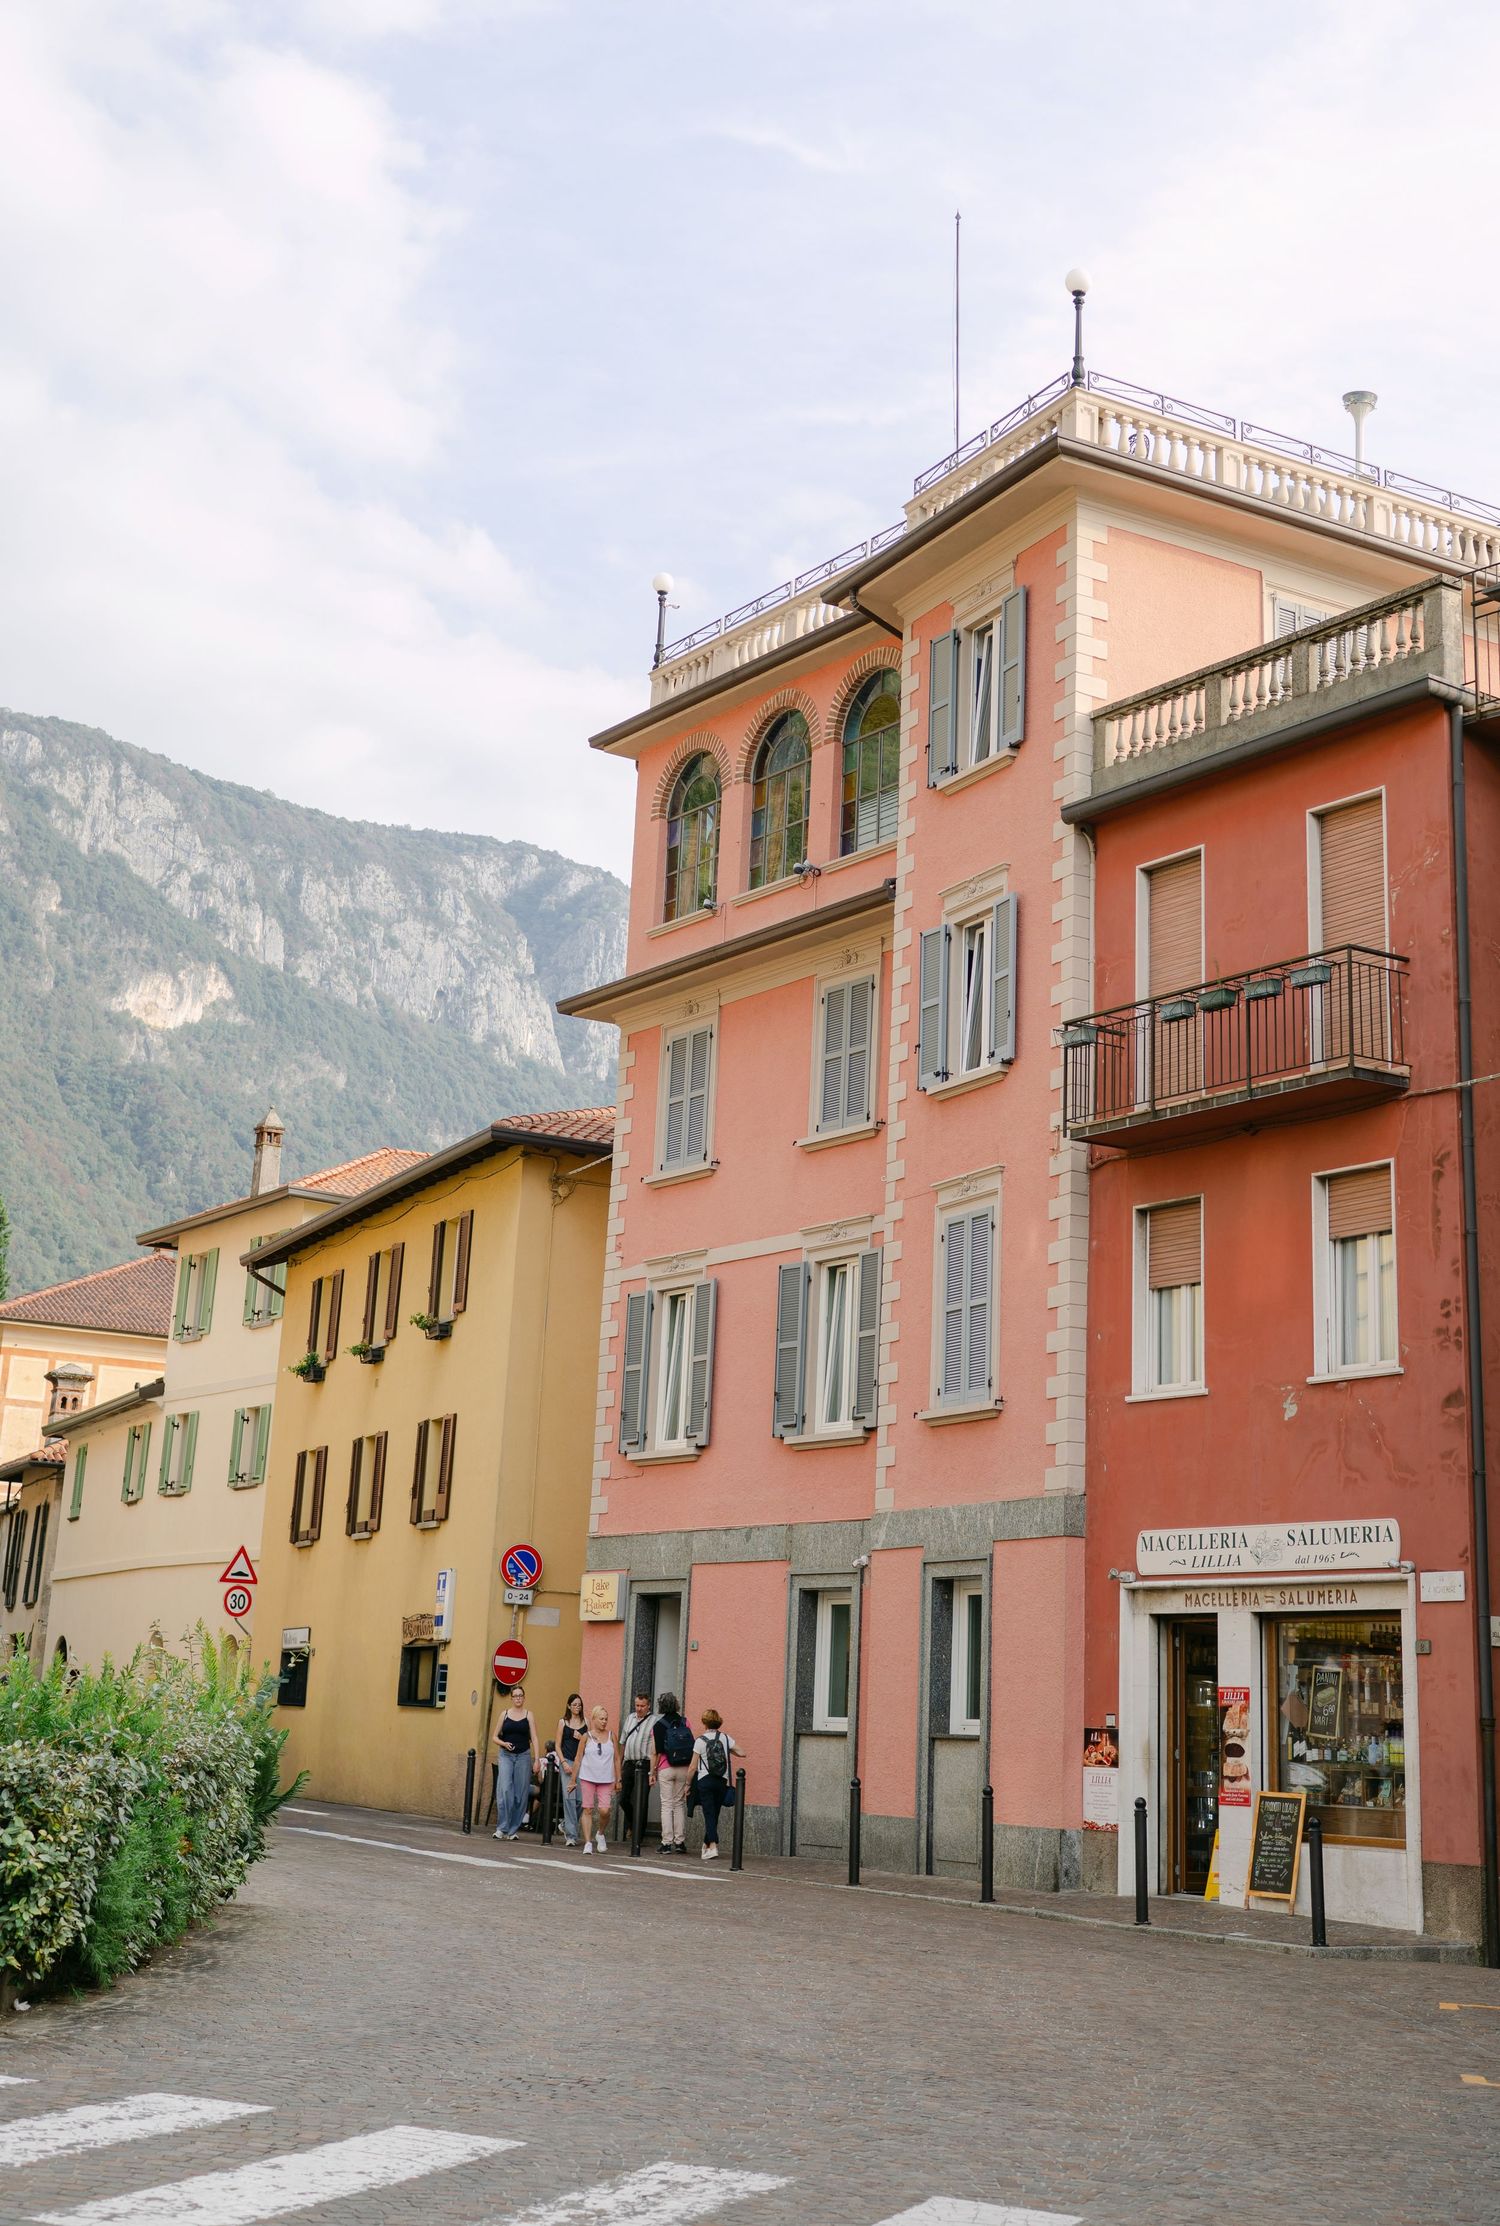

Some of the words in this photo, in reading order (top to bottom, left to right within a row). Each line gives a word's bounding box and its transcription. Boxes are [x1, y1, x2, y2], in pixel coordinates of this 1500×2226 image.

[1140, 1532, 1249, 1553] MACELLERIA
[1286, 1525, 1394, 1547] SALUMERIA
[1191, 1554, 1242, 1568] LILLIA
[1294, 1554, 1310, 1565] dal
[1313, 1553, 1336, 1564] 1965
[592, 1579, 610, 1597] Lake
[230, 1593, 246, 1610] 30
[583, 1598, 616, 1615] Bakery
[1184, 1592, 1260, 1608] MACELLERIA
[1279, 1589, 1358, 1606] SALUMERIA
[1316, 1672, 1338, 1686] PANINI
[1223, 1692, 1244, 1700] LILLIA
